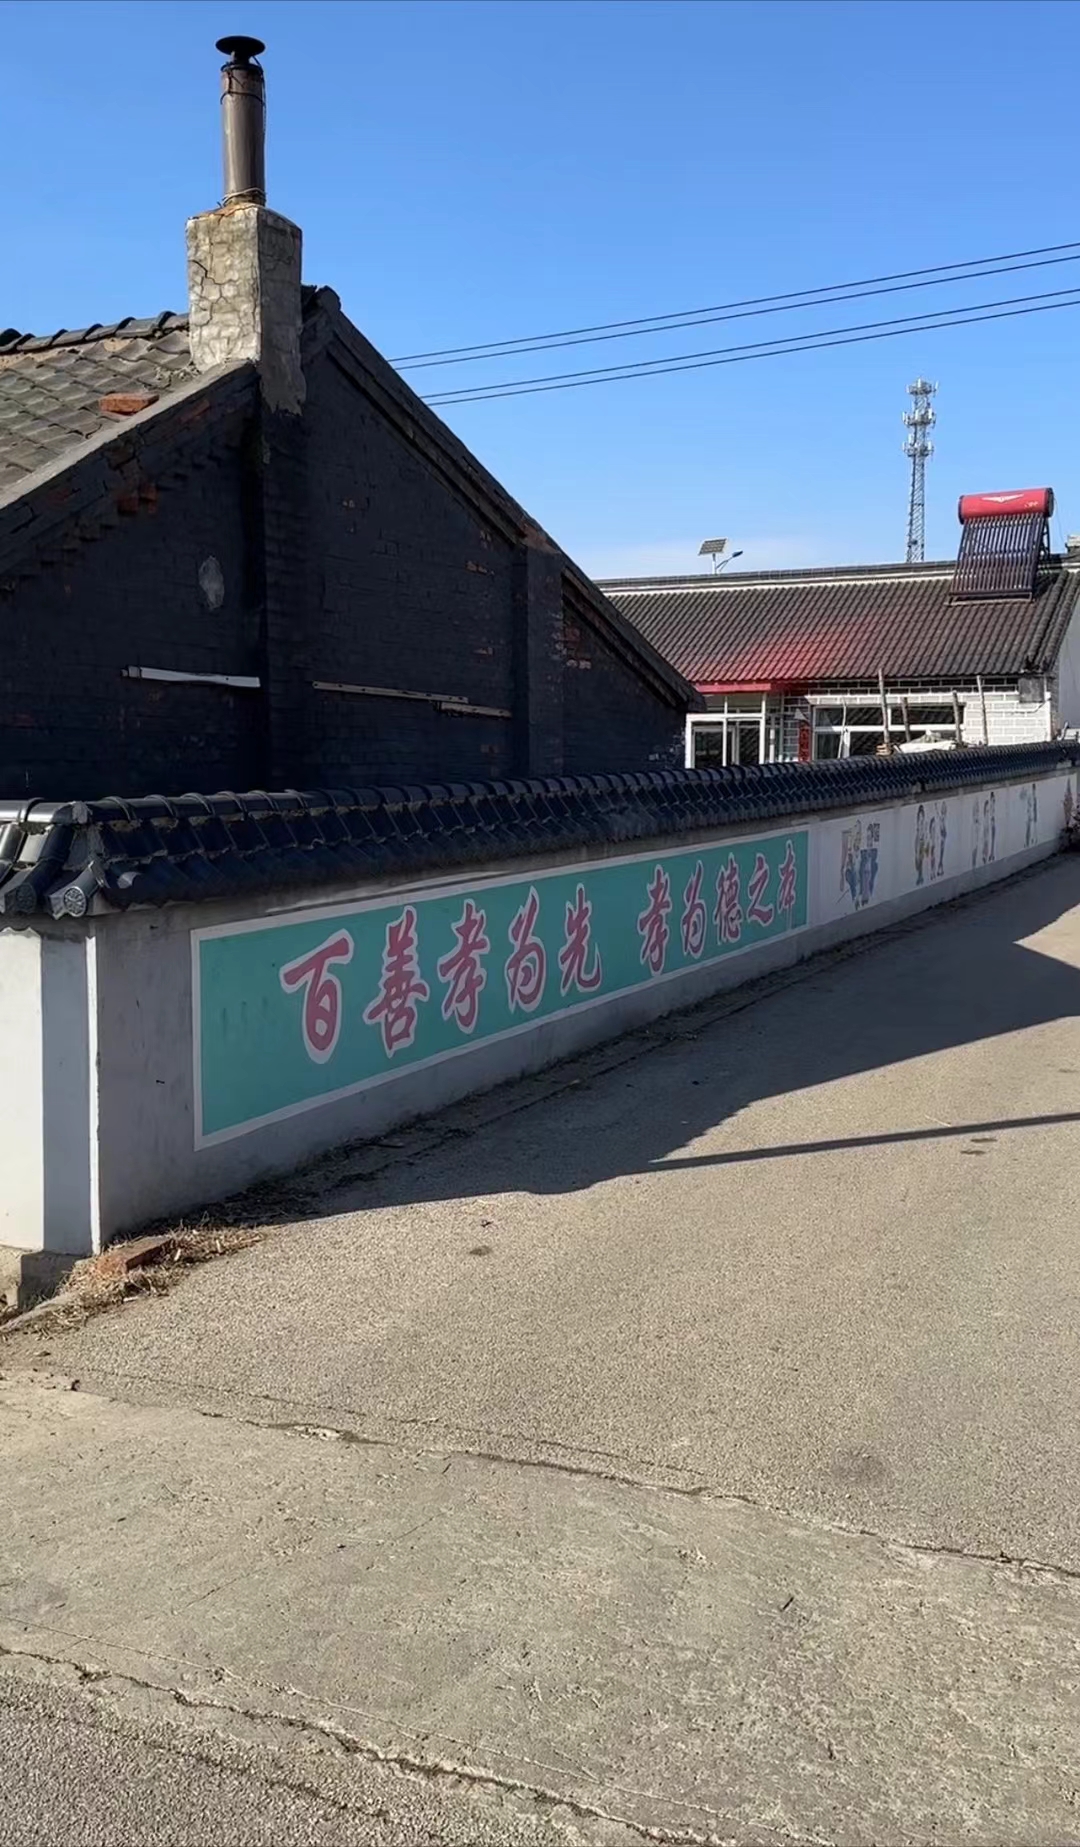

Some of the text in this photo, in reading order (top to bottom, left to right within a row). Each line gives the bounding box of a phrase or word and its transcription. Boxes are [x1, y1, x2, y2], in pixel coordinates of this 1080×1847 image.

[280, 839, 797, 1064] 百善孝为先 孝为德之本
